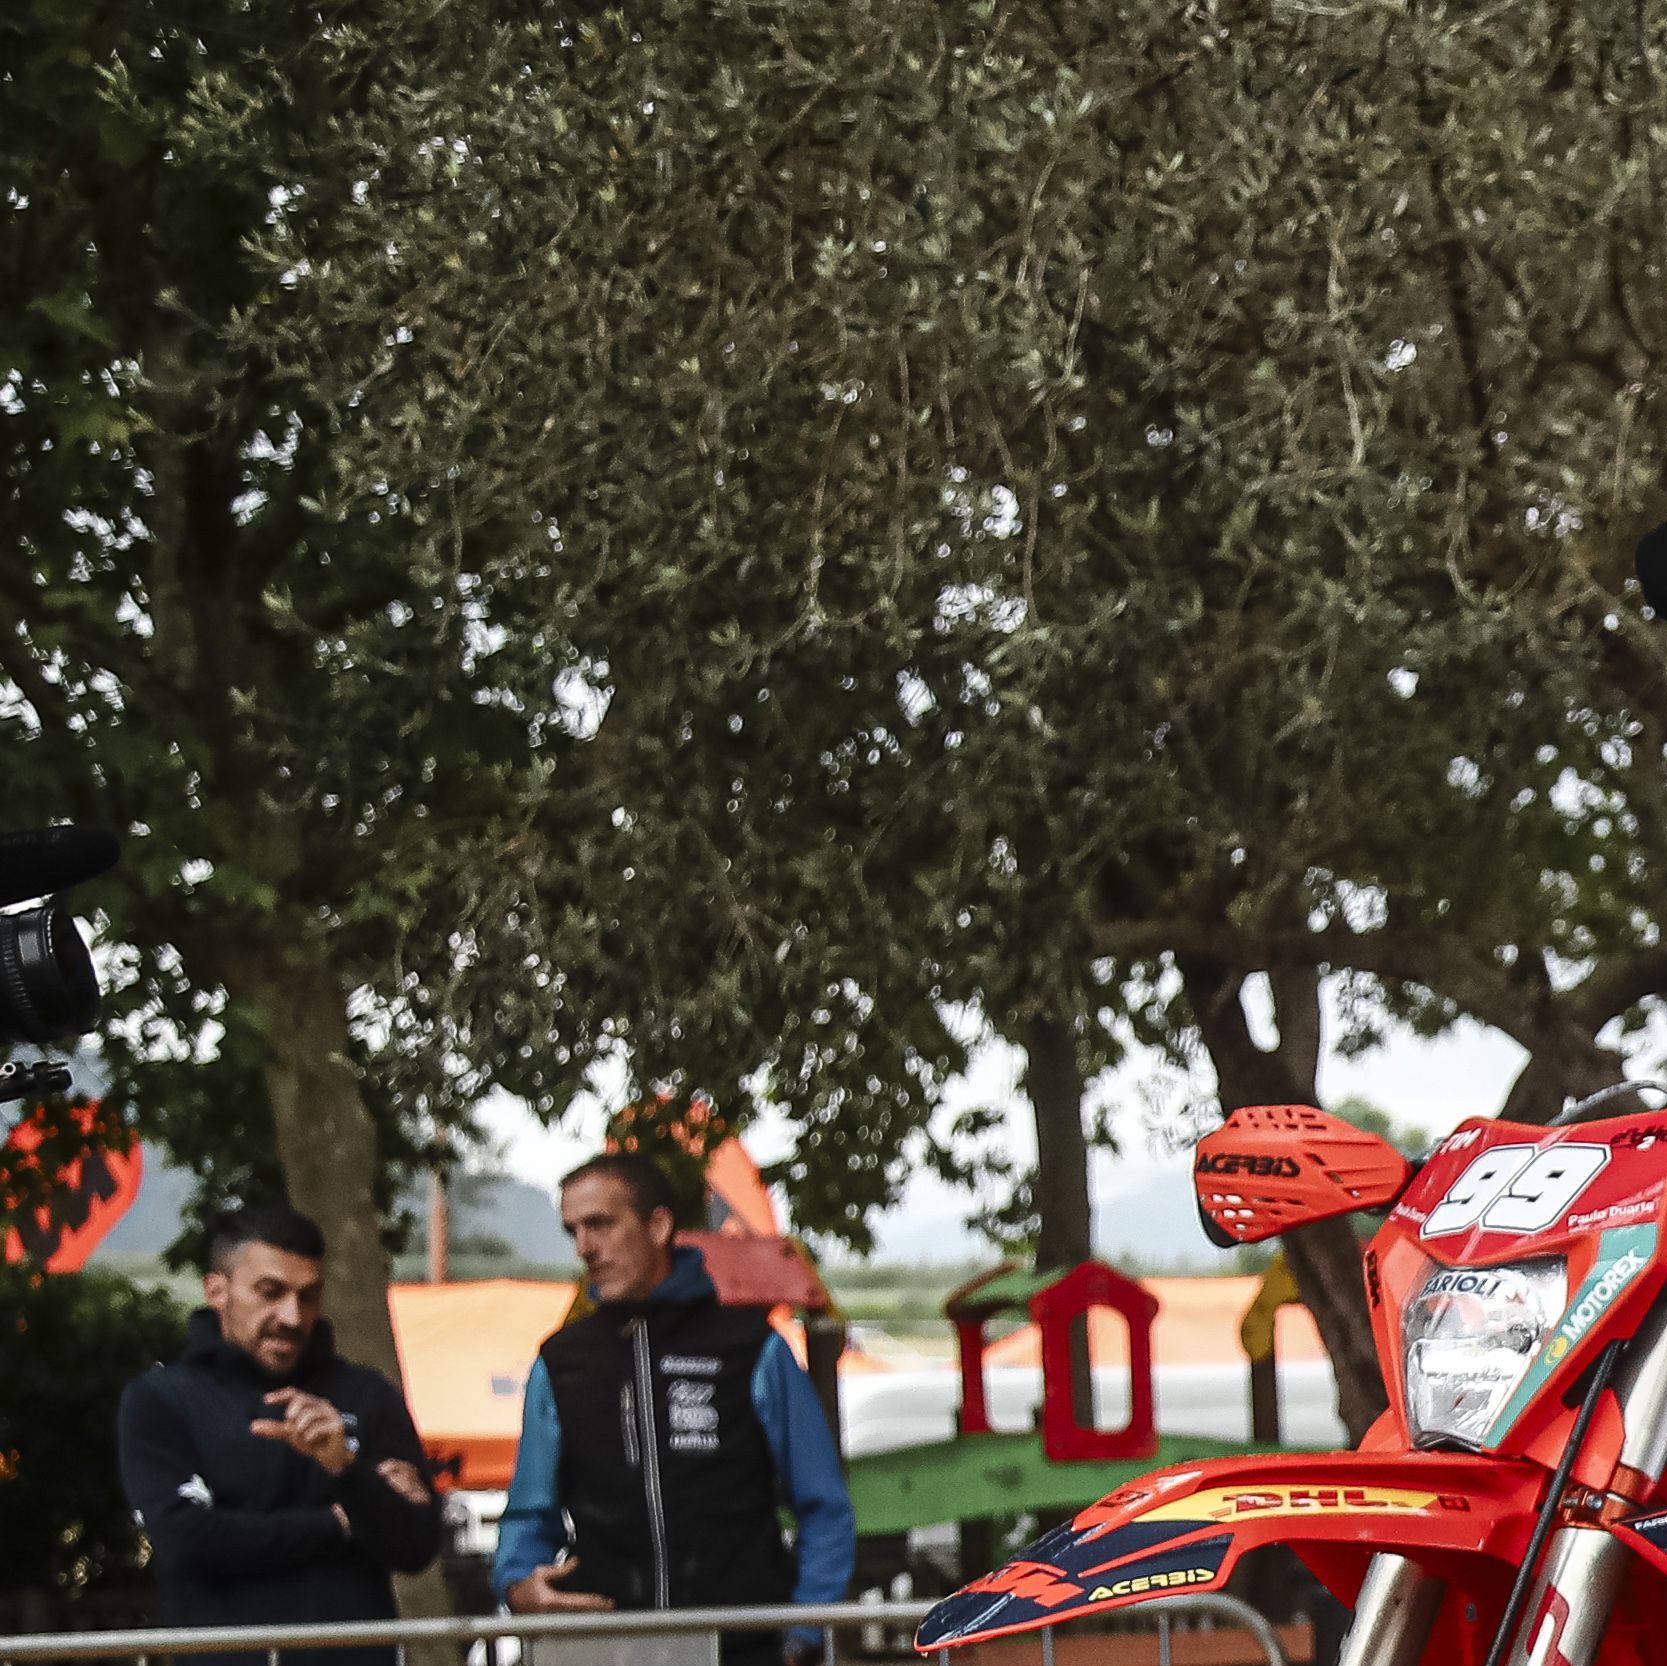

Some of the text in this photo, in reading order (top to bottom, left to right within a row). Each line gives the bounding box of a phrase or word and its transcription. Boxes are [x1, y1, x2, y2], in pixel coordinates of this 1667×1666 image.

[1198, 1151, 1301, 1179] ACERBIS
[1420, 1141, 1614, 1242] 99
[1567, 1200, 1656, 1228] Paulo Duarte
[1562, 1247, 1647, 1344] MOTOREX
[1222, 1489, 1387, 1511] DHL
[1088, 1567, 1216, 1602] ACERBIS
